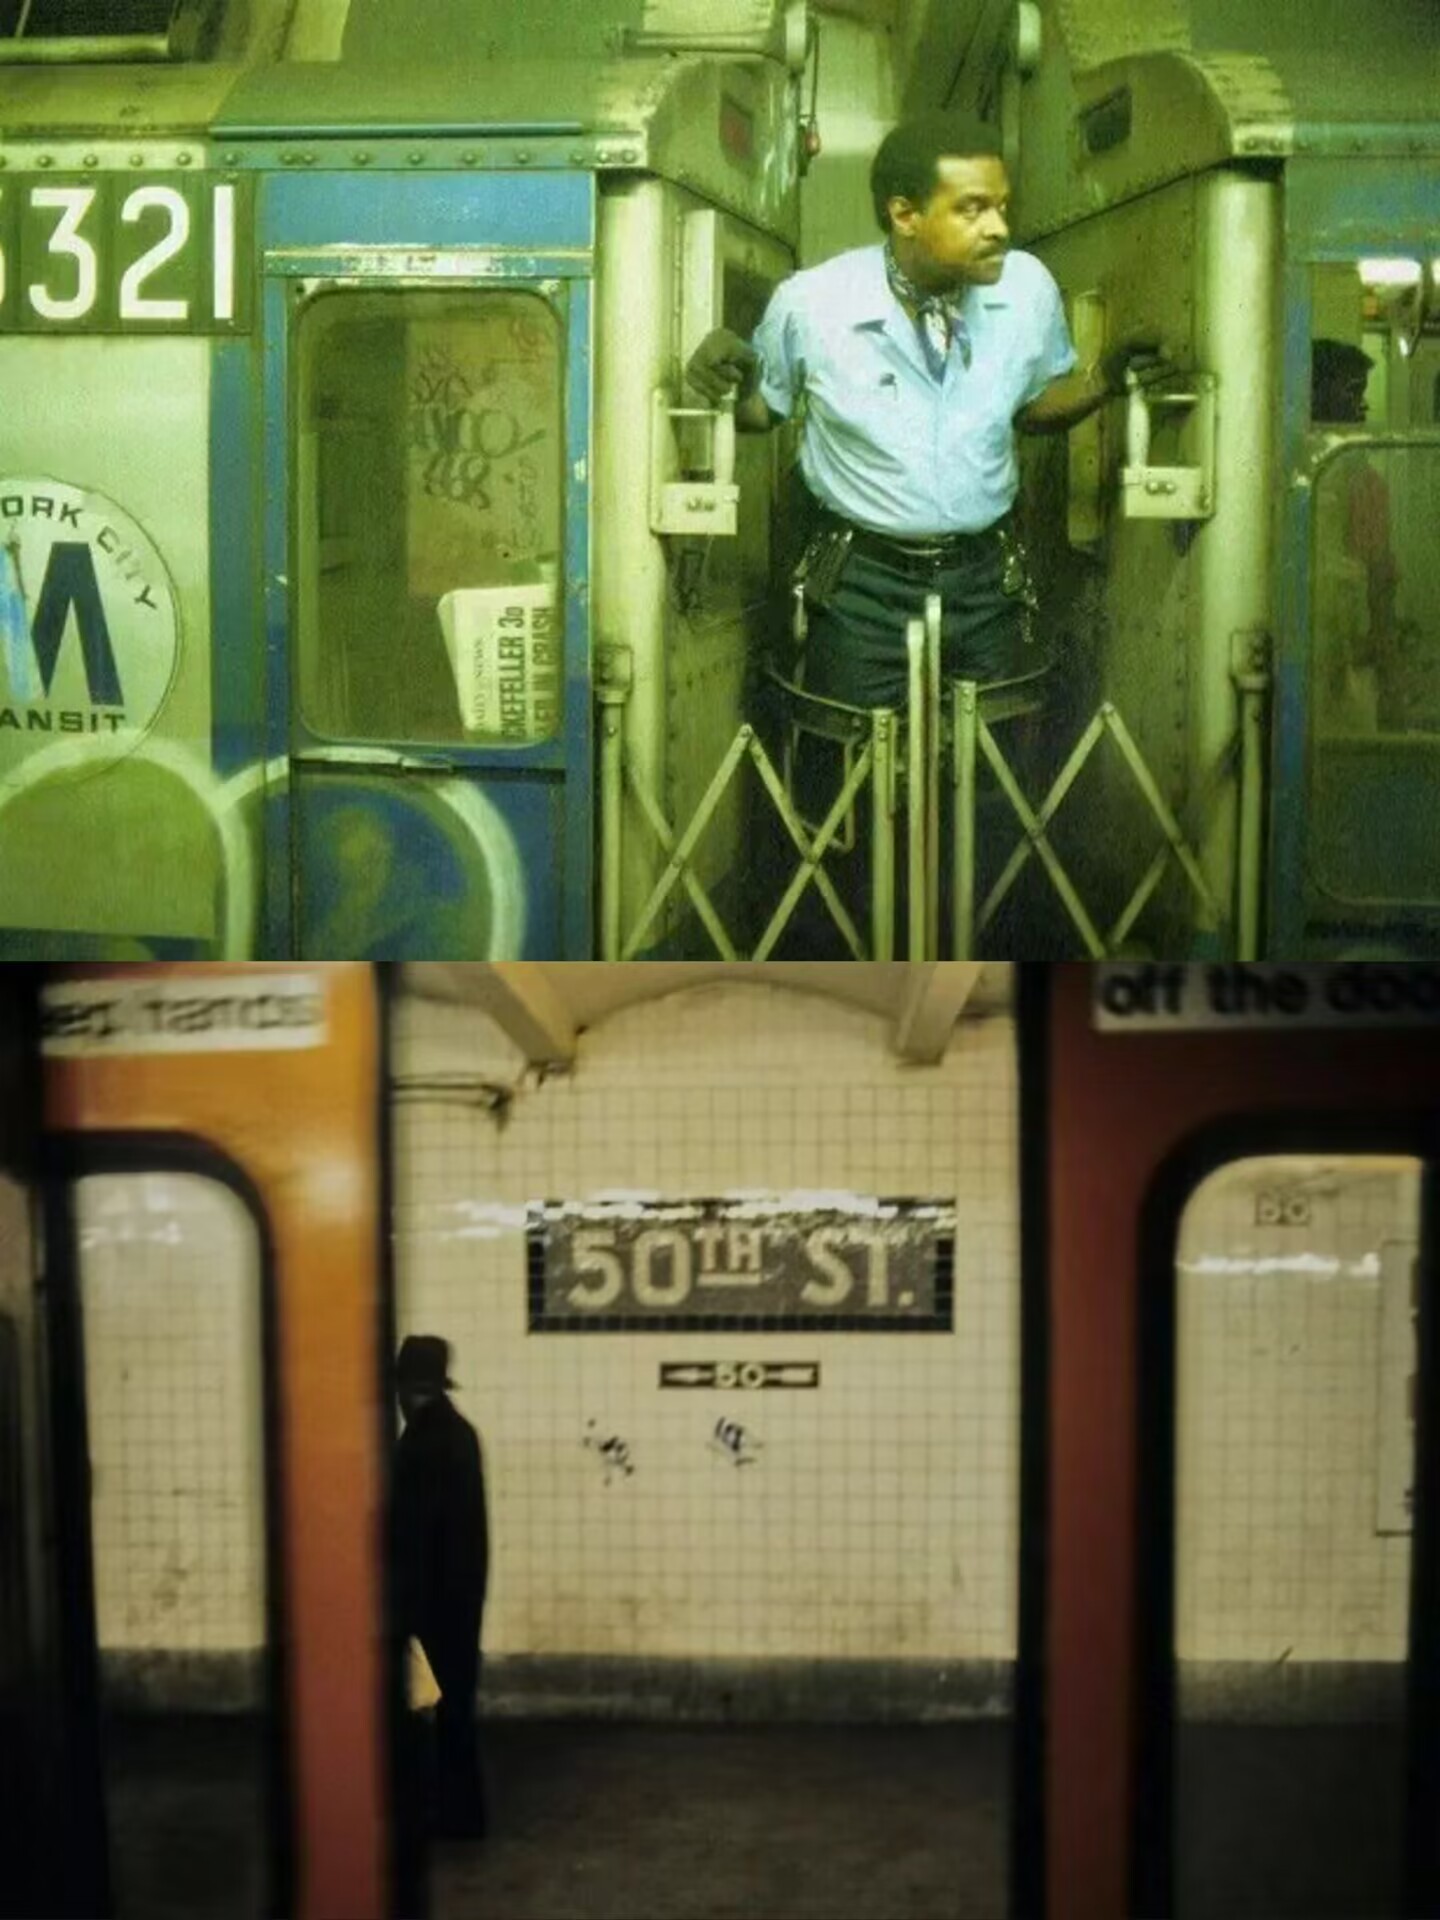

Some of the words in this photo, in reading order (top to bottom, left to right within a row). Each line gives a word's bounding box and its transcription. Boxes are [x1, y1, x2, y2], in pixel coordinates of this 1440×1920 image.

[0, 185, 233, 319] 321
[1204, 963, 1308, 1015] the
[801, 1227, 914, 1307] ST.
[715, 1363, 767, 1389] 50
